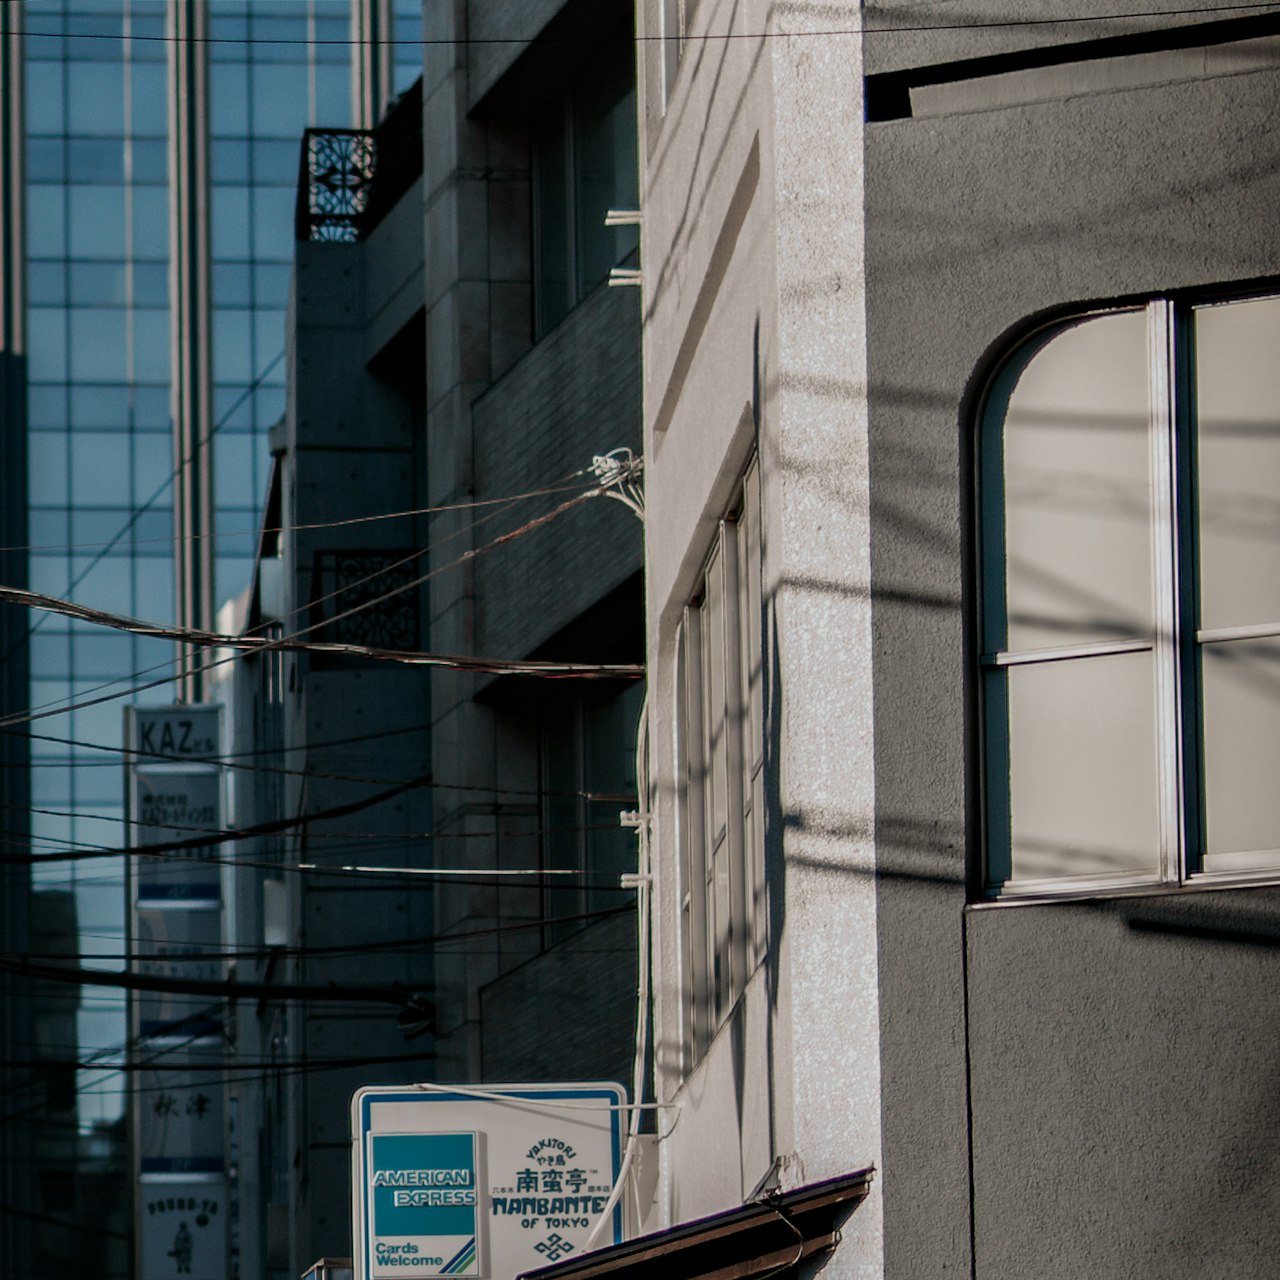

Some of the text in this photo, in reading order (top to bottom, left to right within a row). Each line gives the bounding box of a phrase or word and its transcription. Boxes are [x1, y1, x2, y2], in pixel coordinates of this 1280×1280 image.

[526, 1138, 576, 1160] YAKITORI
[538, 1154, 566, 1166] やき鳥
[372, 1169, 470, 1186] AMERICAN
[516, 1168, 587, 1193] 南蛮亭
[394, 1190, 476, 1207] EXPRESS
[521, 1217, 589, 1229] OF TOKYO
[375, 1243, 419, 1255] Cards
[376, 1255, 443, 1267] Welcome
